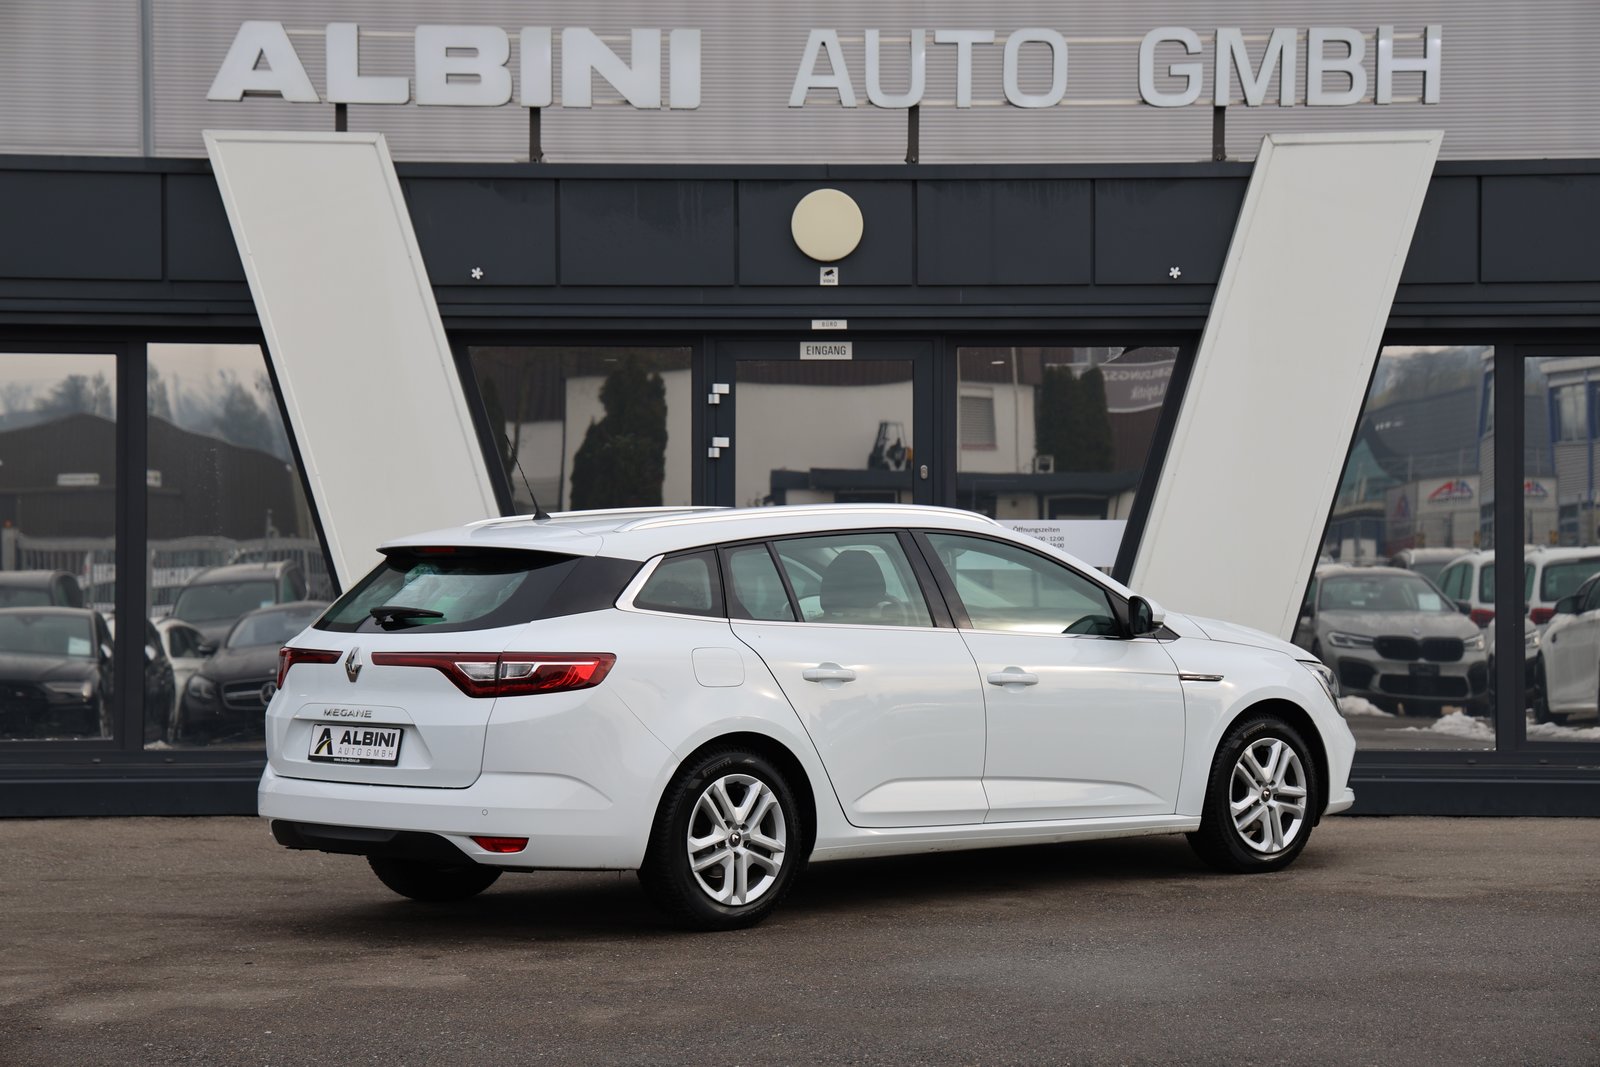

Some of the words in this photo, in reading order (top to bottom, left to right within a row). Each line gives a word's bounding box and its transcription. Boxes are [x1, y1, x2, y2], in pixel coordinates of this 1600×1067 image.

[206, 20, 700, 109] ALBINI
[788, 27, 1069, 109] AUTO
[1137, 25, 1443, 108] GMBH
[806, 345, 846, 356] EINGANG
[1013, 525, 1061, 533] Öffnungszeiten
[340, 730, 396, 748] ALBINI
[338, 747, 362, 756] AUTO
[366, 749, 394, 758] GMBH
